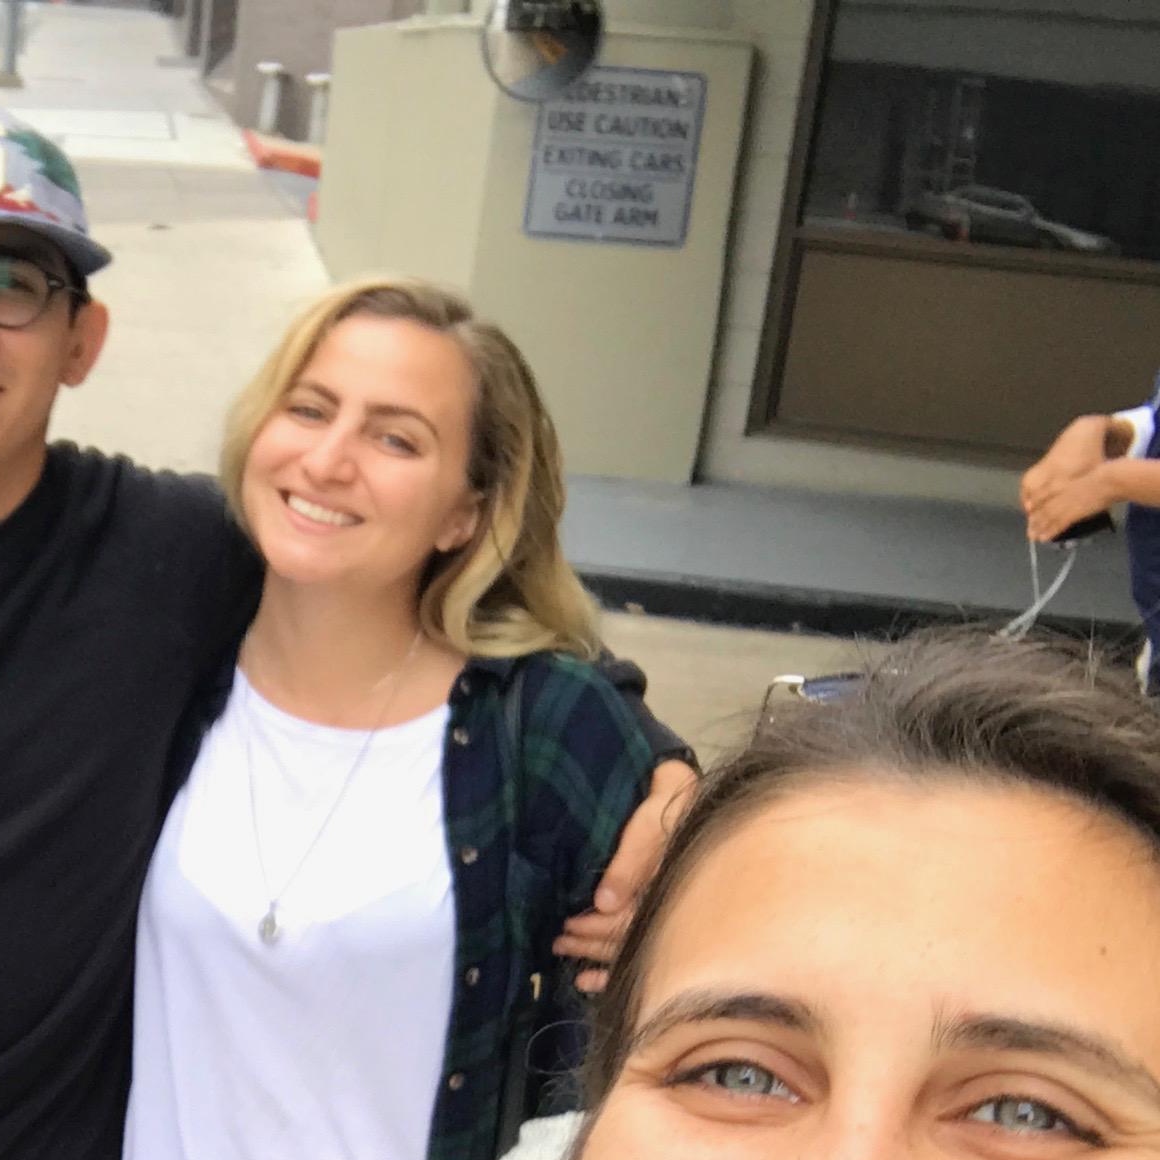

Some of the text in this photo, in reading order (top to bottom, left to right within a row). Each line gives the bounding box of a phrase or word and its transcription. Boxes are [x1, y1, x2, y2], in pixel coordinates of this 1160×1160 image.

[548, 110, 689, 139] USE CAUTION
[543, 145, 684, 172] EXITING CARS
[565, 177, 653, 204] CLOSING
[554, 202, 658, 226] GATE ARM
